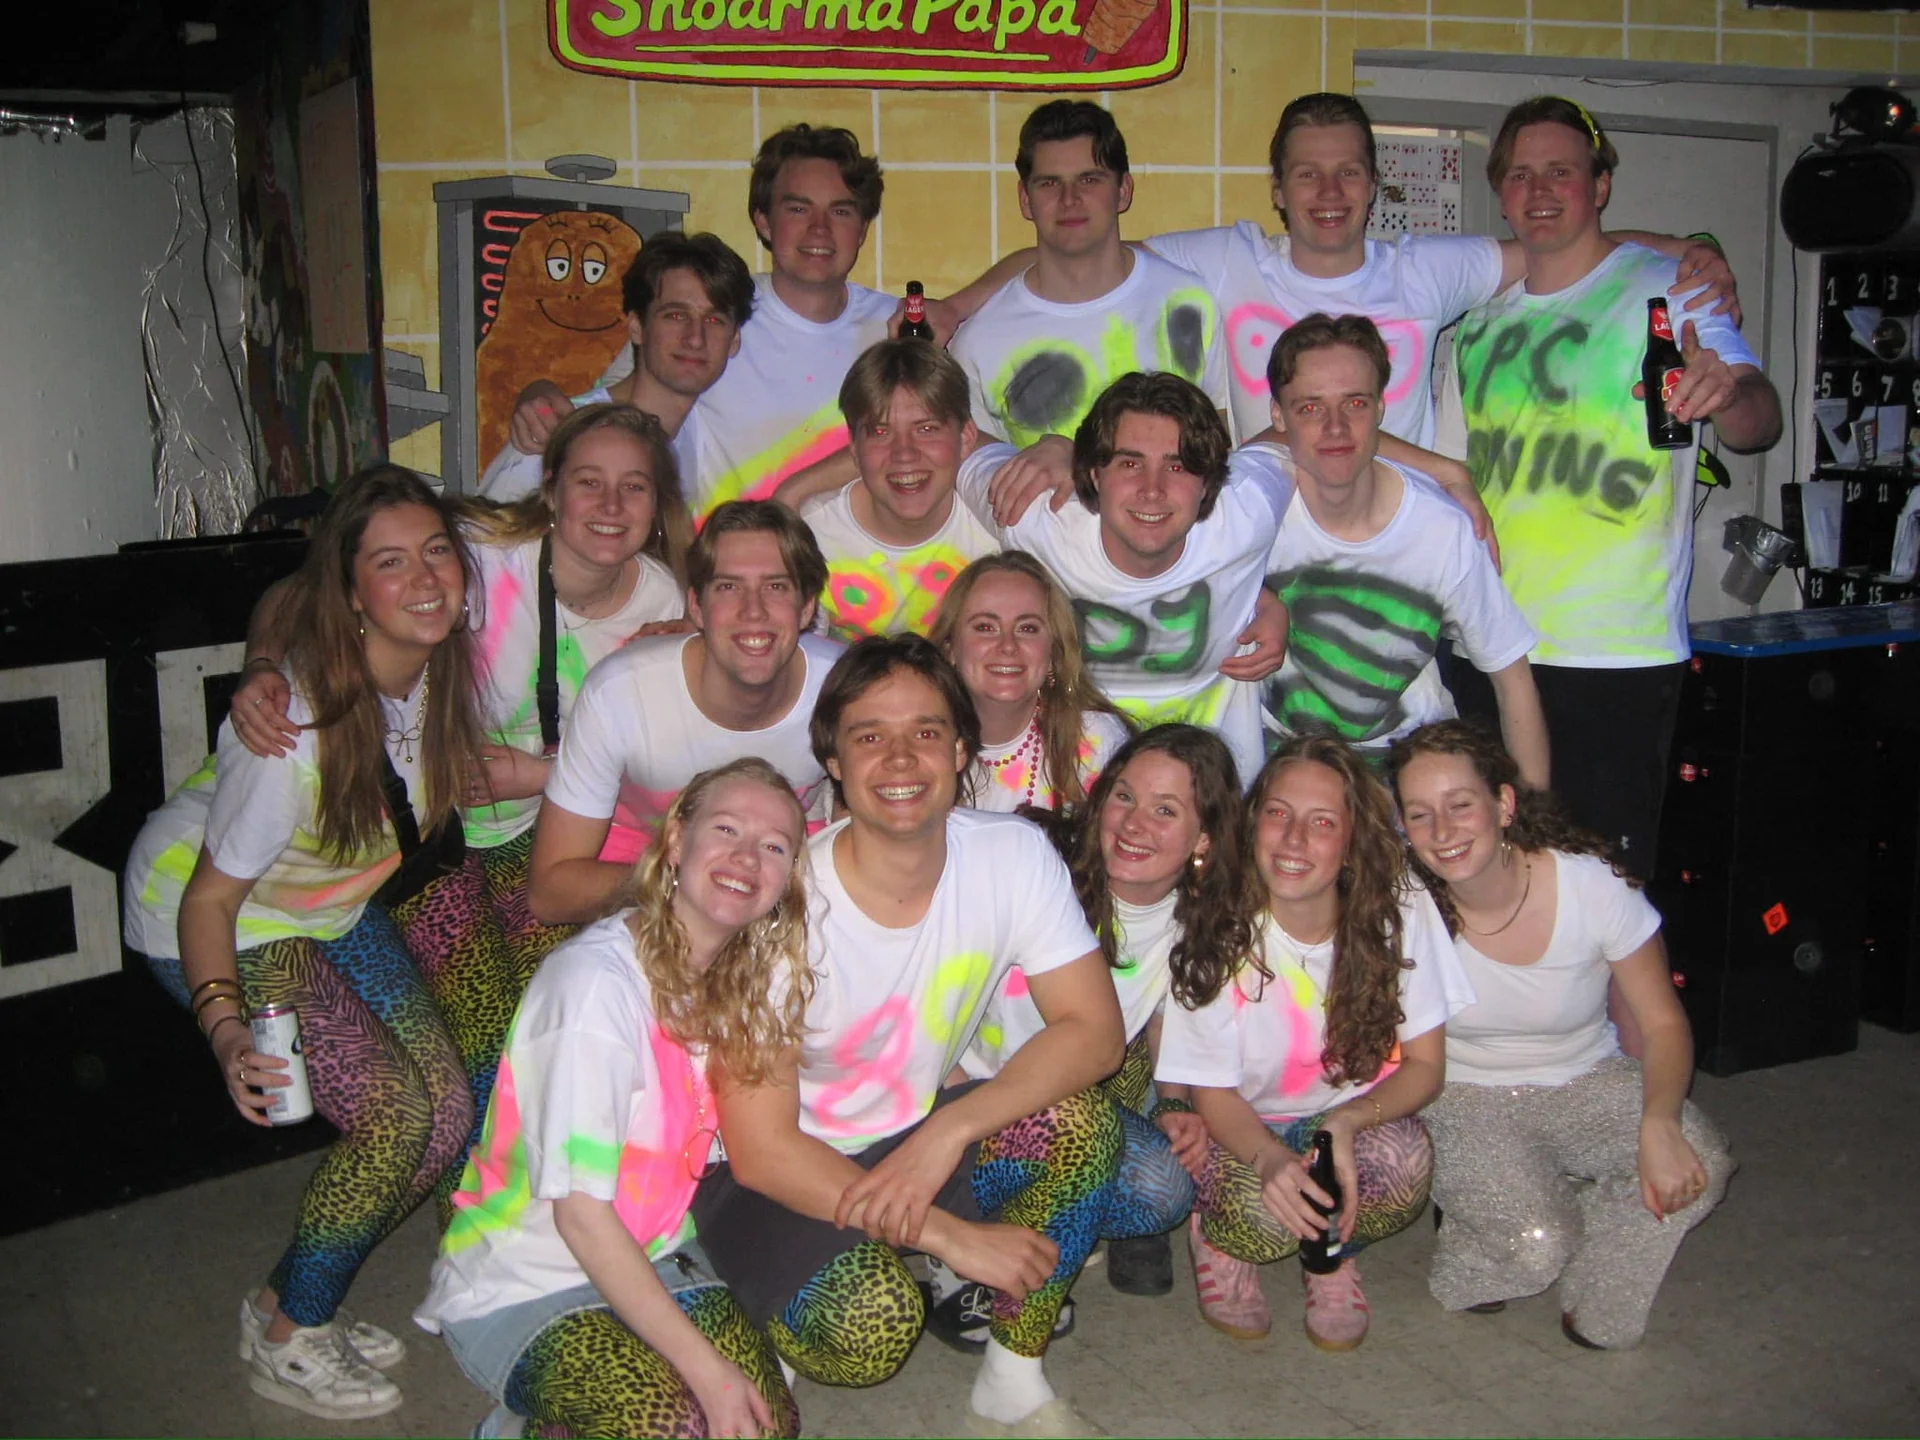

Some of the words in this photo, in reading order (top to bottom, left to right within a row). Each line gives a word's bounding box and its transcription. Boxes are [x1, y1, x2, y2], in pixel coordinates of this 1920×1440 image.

[1827, 276, 1837, 306] 1
[1857, 272, 1869, 299] 2
[1887, 274, 1899, 301] 3
[1820, 371, 1833, 399] 5
[1851, 369, 1862, 398] 6
[1881, 374, 1894, 402] 7
[1846, 481, 1861, 503] 10
[1877, 483, 1889, 503] 11
[1810, 576, 1823, 600] 13
[1840, 581, 1856, 606] 14
[1868, 585, 1883, 606] 15
[1070, 580, 1212, 675] DJ
